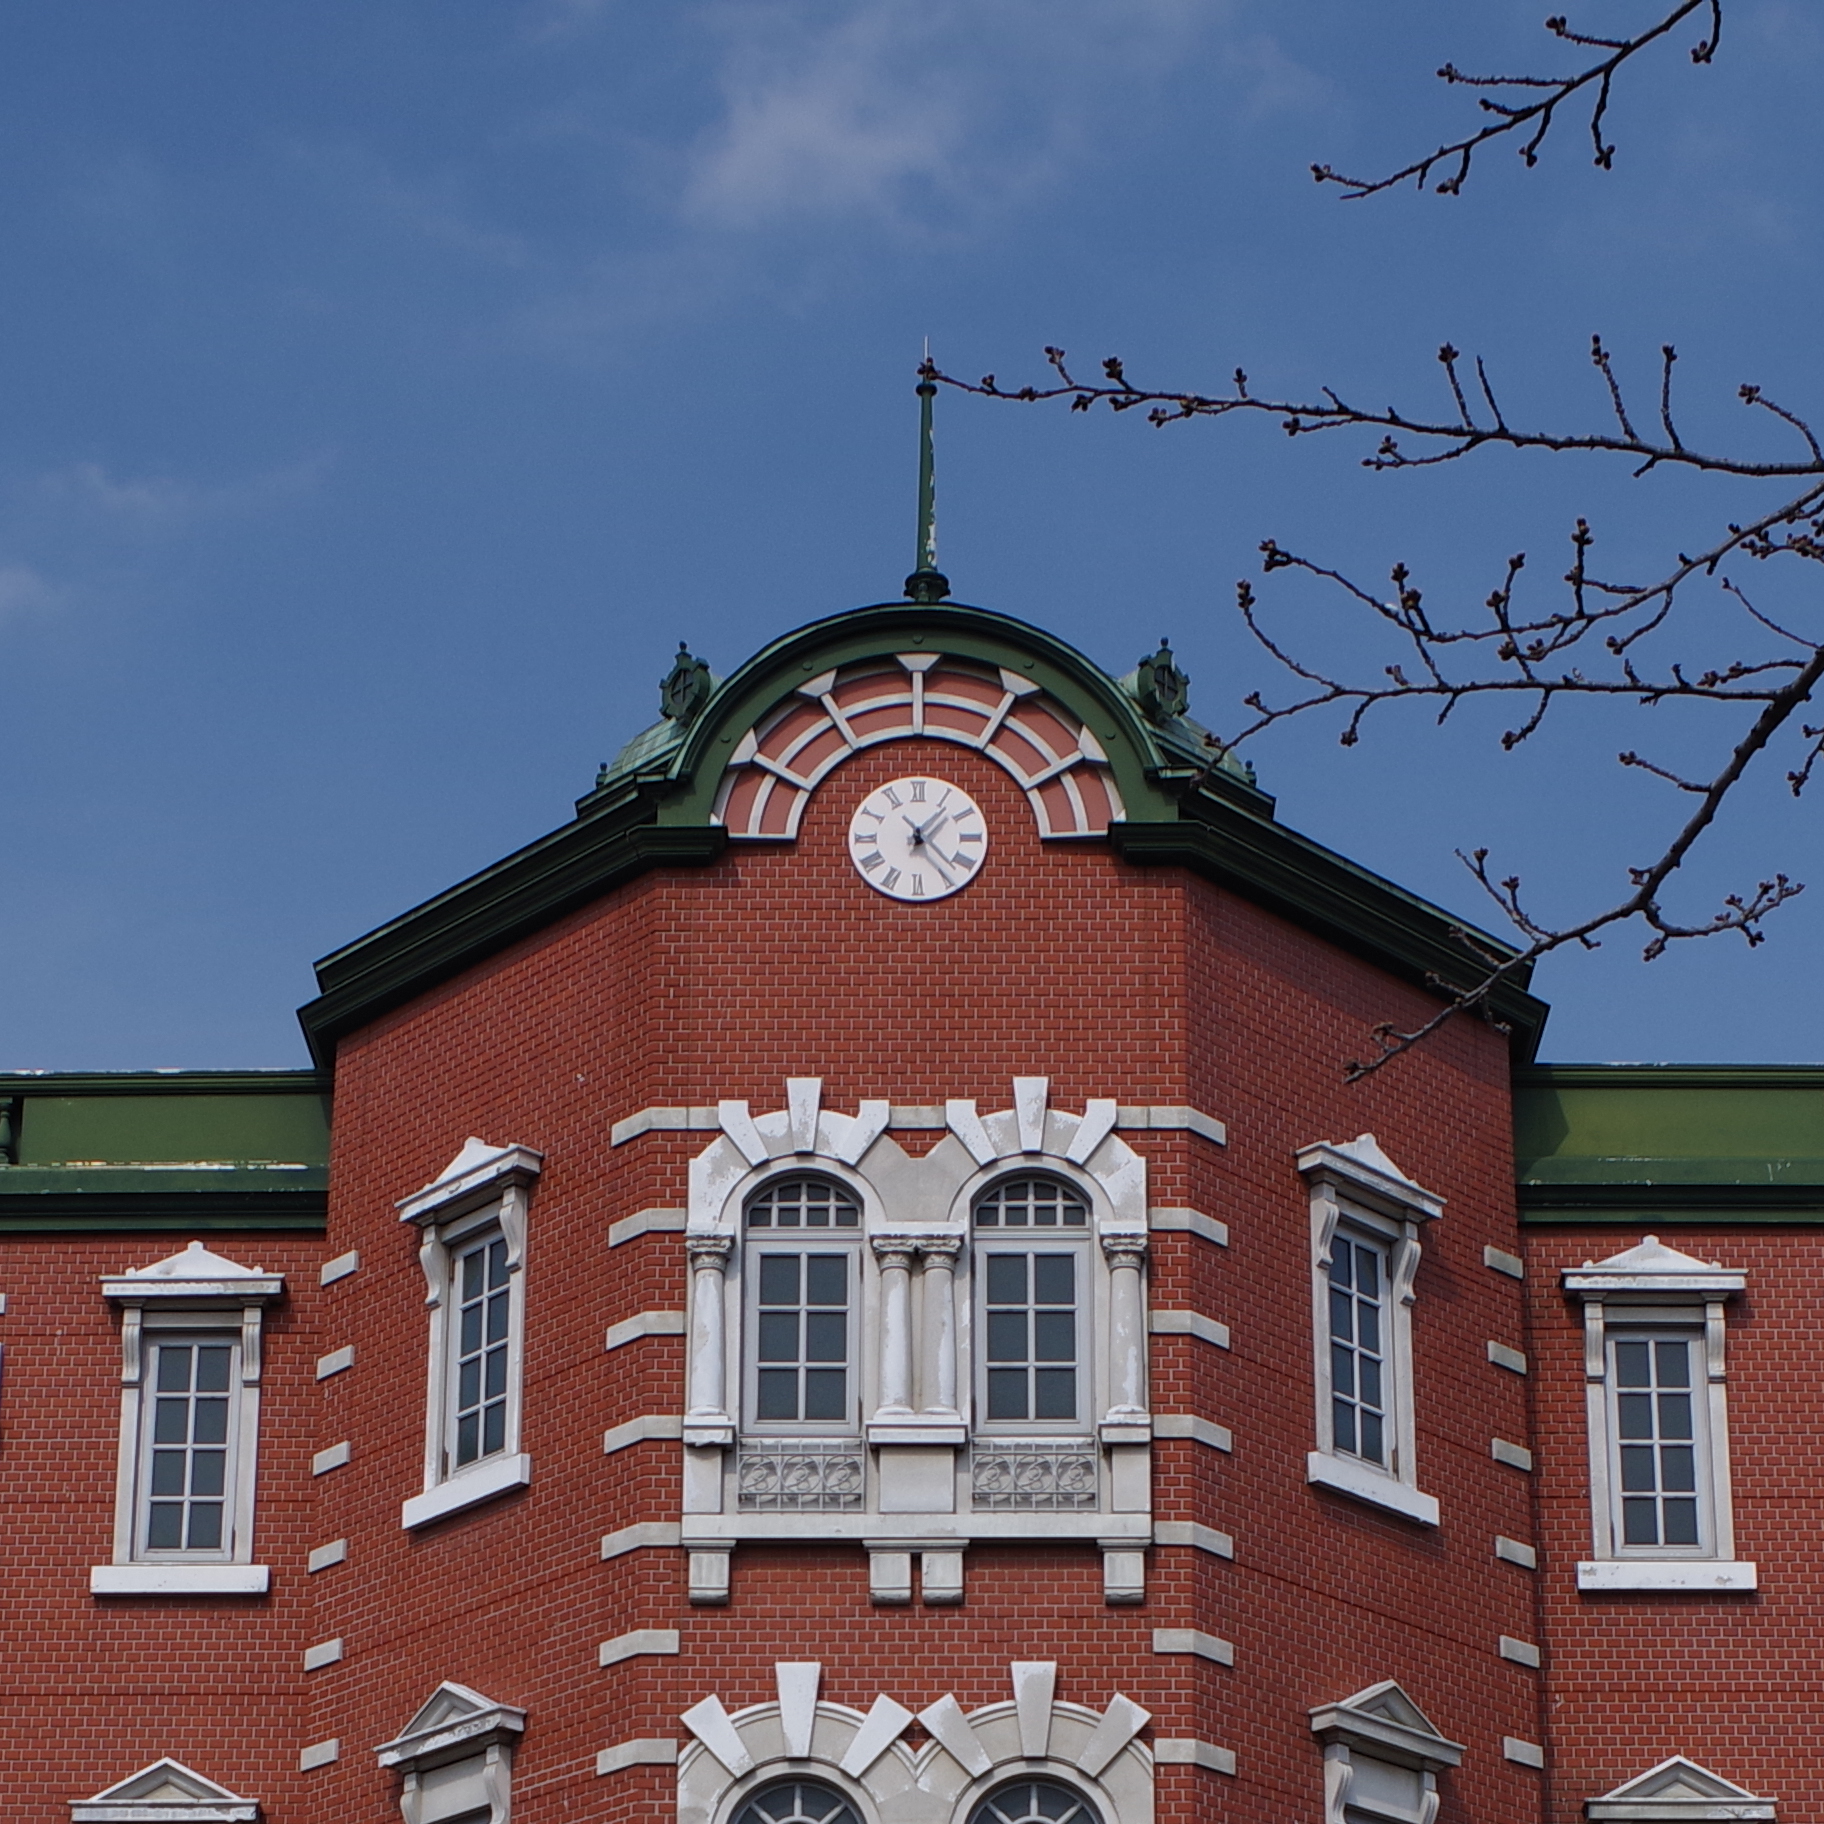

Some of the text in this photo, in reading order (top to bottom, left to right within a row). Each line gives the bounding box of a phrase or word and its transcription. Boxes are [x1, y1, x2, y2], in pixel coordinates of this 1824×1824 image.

[910, 781, 926, 802] XII
[936, 787, 952, 807] I
[911, 874, 925, 896] VI
